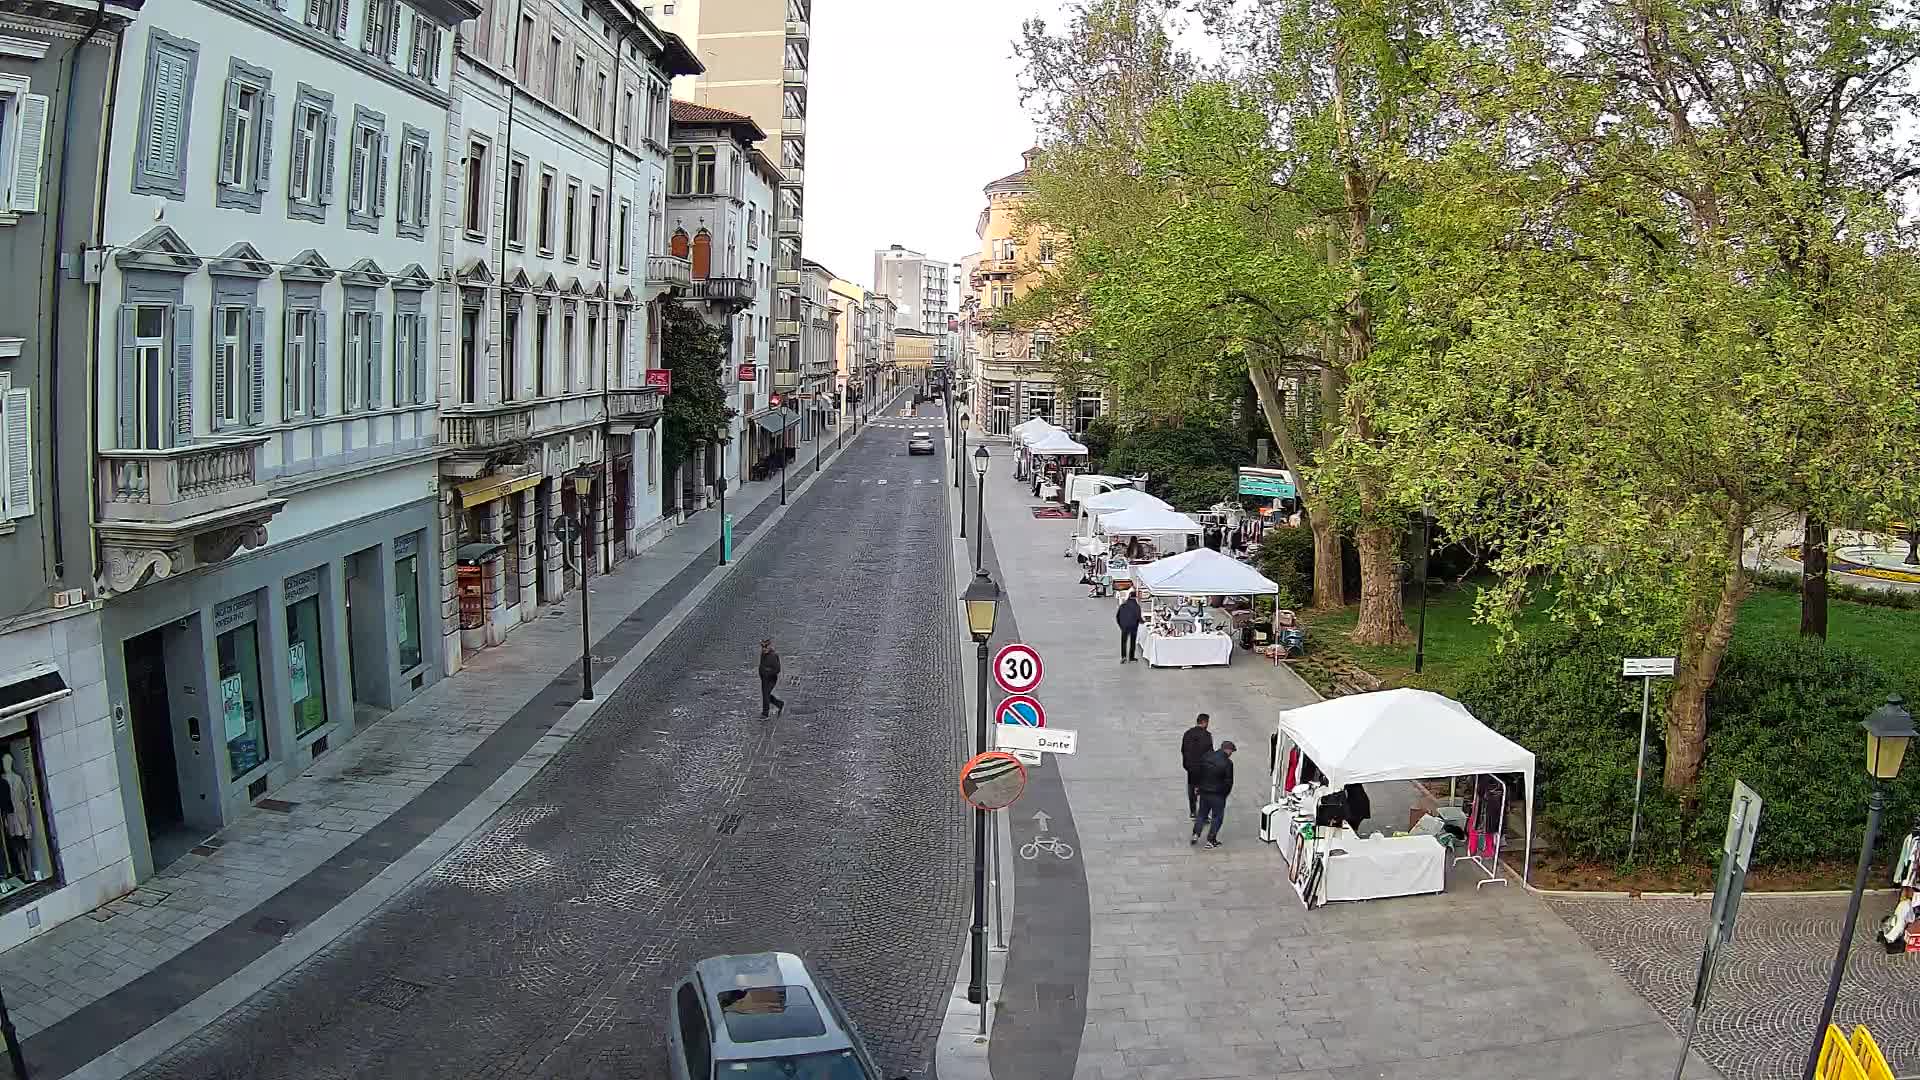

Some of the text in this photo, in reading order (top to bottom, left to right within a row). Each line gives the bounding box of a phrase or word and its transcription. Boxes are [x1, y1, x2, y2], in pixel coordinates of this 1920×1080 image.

[1005, 658, 1033, 680] 30
[222, 677, 241, 699] 130
[1038, 738, 1070, 749] Dante
